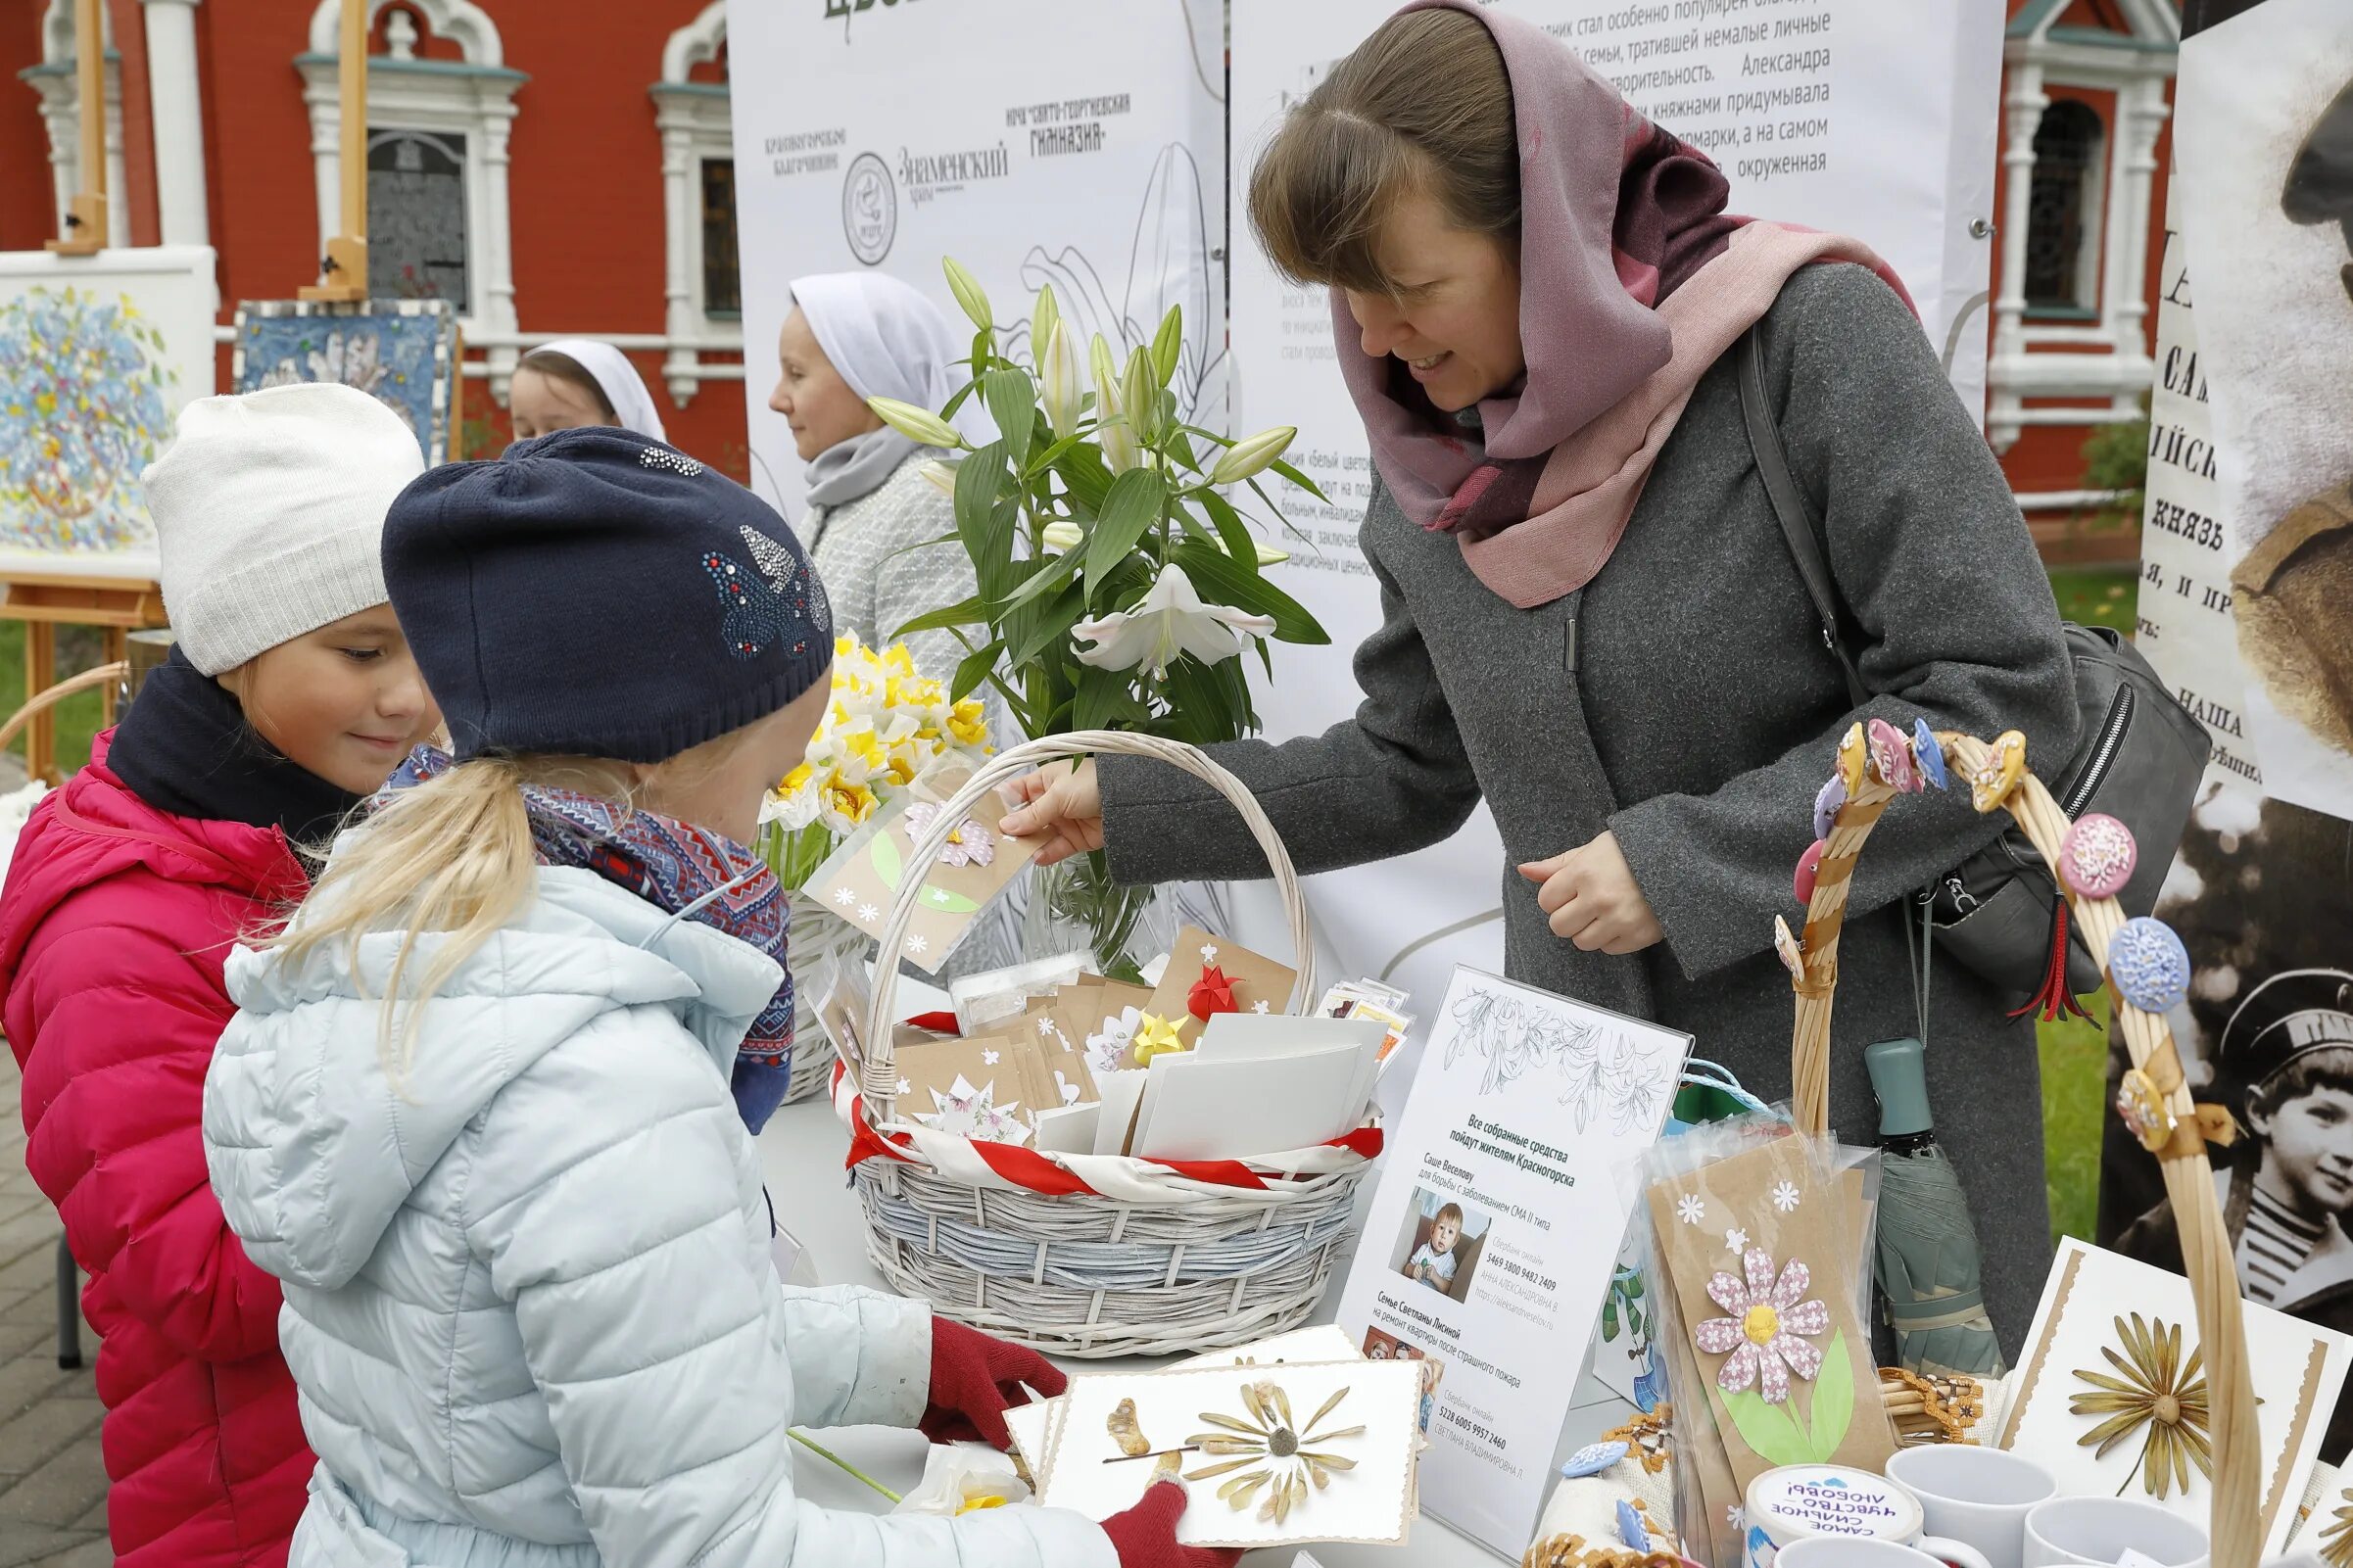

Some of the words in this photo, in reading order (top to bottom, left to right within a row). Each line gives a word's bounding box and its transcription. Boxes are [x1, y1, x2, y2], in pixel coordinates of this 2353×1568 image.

[1577, 16, 1604, 35] стал
[1608, 5, 1669, 29] особенно
[1584, 44, 1624, 65] семьи,
[1628, 28, 1699, 62] тратившей
[1705, 22, 1768, 47] немалые
[1774, 13, 1831, 38] личные
[1742, 48, 1831, 75] Александра
[1654, 95, 1721, 120] княжнами
[1727, 83, 1830, 117] придумывала
[1743, 126, 1752, 143] а
[1756, 123, 1774, 142] на
[1778, 118, 1829, 139] самом
[898, 139, 1009, 186] Знаменский
[1738, 153, 1827, 182] окруженная
[2151, 498, 2224, 552] КНЯЗЬ
[2176, 575, 2193, 598] И
[2180, 687, 2243, 739] НАША
[1468, 1114, 1483, 1130] Все
[1483, 1123, 1529, 1149] собранные
[1529, 1140, 1568, 1164] средства
[1423, 1152, 1442, 1168] Саше
[1442, 1160, 1474, 1184] Веселову
[1449, 1129, 1479, 1151] пойдут
[1478, 1141, 1516, 1164] жителям
[1515, 1153, 1575, 1188] Красногорска
[1417, 1168, 1431, 1179] для
[1431, 1171, 1457, 1191] борьбы
[1457, 1184, 1463, 1194] с
[1462, 1186, 1511, 1213] заболеванием
[1511, 1205, 1526, 1221] СМА
[1534, 1216, 1551, 1231] типа
[1492, 1236, 1520, 1258] Сбербанк
[1521, 1251, 1544, 1267] онлайн
[1480, 1269, 1498, 1286] АННА
[1498, 1277, 1552, 1310] АЛЕКСАНДРОВНА
[1486, 1253, 1504, 1267] 5469
[1504, 1259, 1521, 1276] 3800
[1520, 1267, 1539, 1284] 9482
[1538, 1275, 1557, 1292] 2409
[1377, 1290, 1399, 1309] Семье
[1399, 1301, 1432, 1326] Светланы
[1432, 1316, 1462, 1341] Лисиной
[1372, 1307, 1381, 1318] на
[1381, 1311, 1407, 1330] ремонт
[1407, 1322, 1438, 1346] квартиры
[1438, 1340, 1458, 1356] после
[1457, 1350, 1494, 1375] страшного
[1494, 1368, 1521, 1389] пожара
[1443, 1389, 1471, 1410] Сбербанк
[1471, 1406, 1494, 1424] онлайн
[1438, 1405, 1456, 1422] 5228
[1455, 1415, 1472, 1431] 6005
[1471, 1424, 1489, 1440] 9957
[1488, 1432, 1507, 1449] 2460
[1434, 1422, 1465, 1448] СВЕТЛАНА
[1464, 1440, 1516, 1477] ВЛАДИМИРОВНА
[1788, 1481, 1886, 1504] ЛЮБОВЬ!
[1802, 1497, 1897, 1517] ЧУВСТВО
[1770, 1503, 1863, 1526] СИЛЬНОЕ
[1809, 1520, 1875, 1537] САМОЕ
